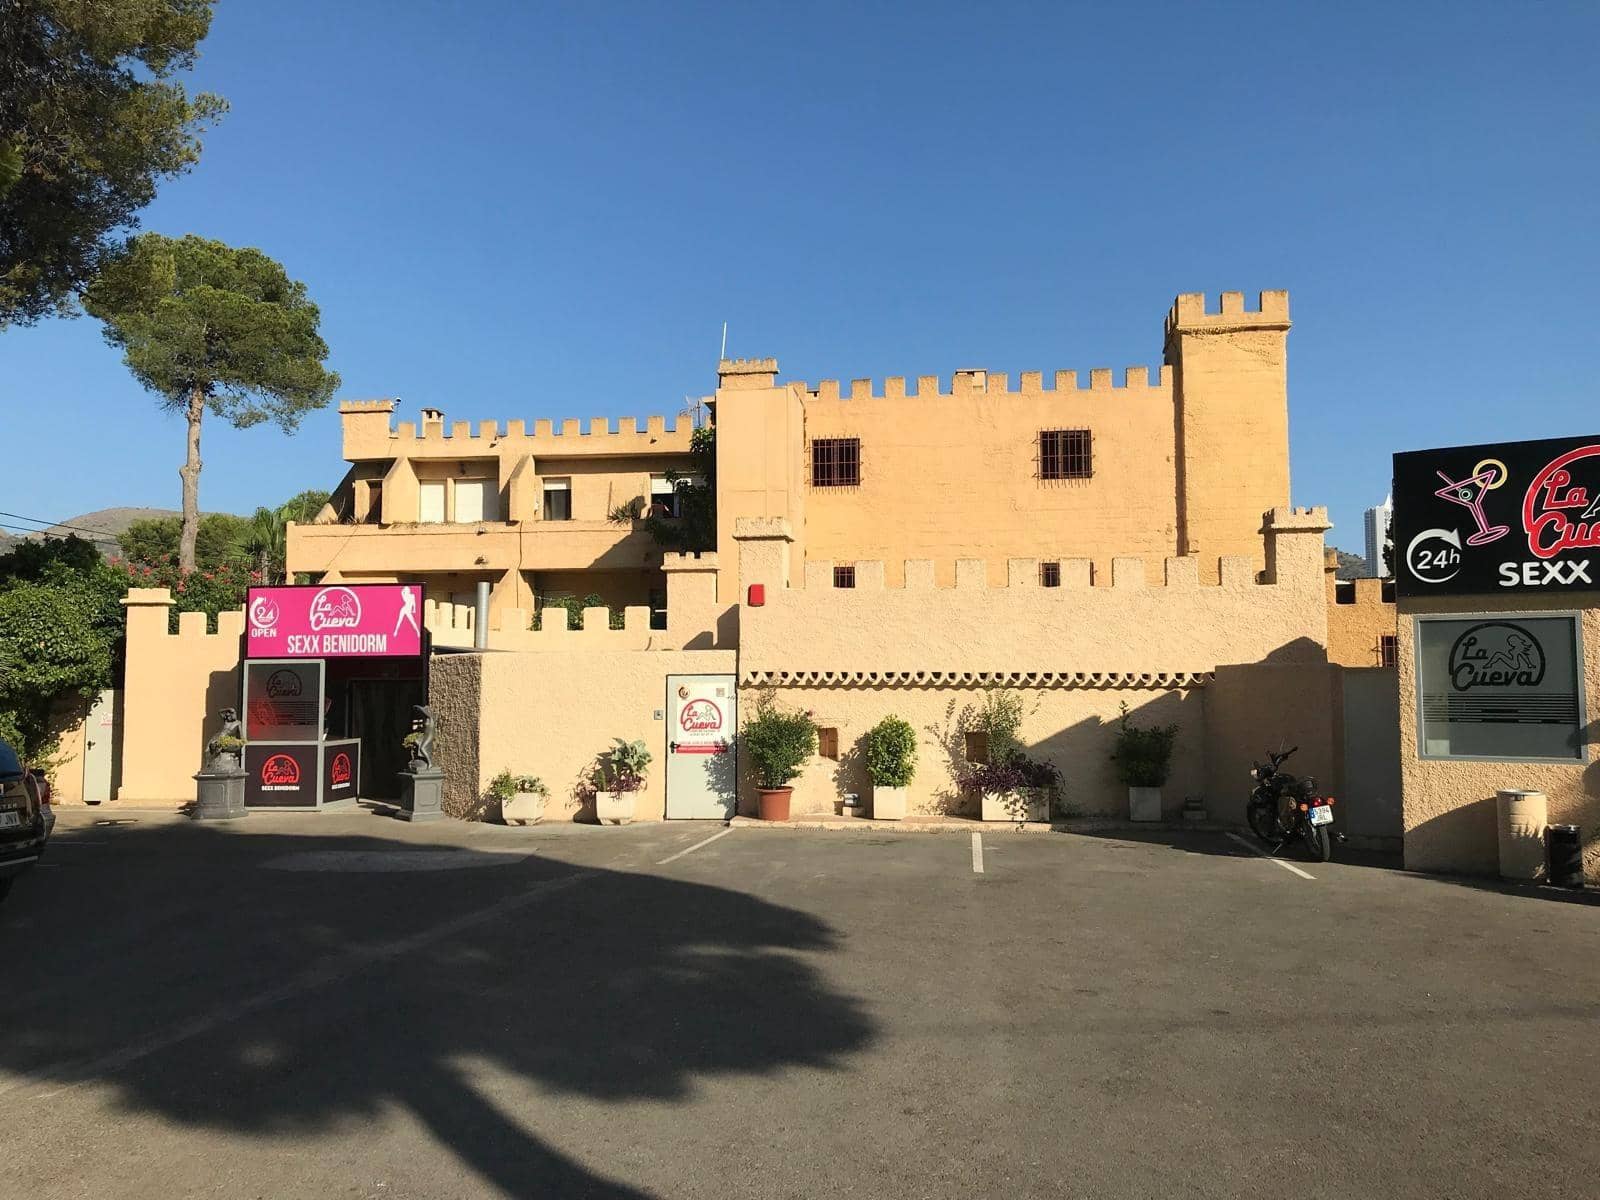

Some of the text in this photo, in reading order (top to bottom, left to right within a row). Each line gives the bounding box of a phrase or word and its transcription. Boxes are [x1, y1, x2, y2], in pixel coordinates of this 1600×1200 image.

[1542, 469, 1590, 511] La
[1528, 511, 1600, 559] Cue
[1416, 548, 1461, 570] 24h
[1499, 559, 1593, 587] SEXX
[317, 594, 332, 612] La
[256, 606, 275, 620] 24
[311, 612, 358, 631] Cueva
[251, 628, 277, 638] OPEN
[287, 634, 387, 654] SEXX BENIDORM
[1461, 636, 1489, 661] La
[1451, 662, 1538, 692] Cueva
[686, 704, 698, 717] La
[682, 717, 719, 731] Cueva
[267, 760, 278, 772] La
[263, 772, 298, 785] Cueva
